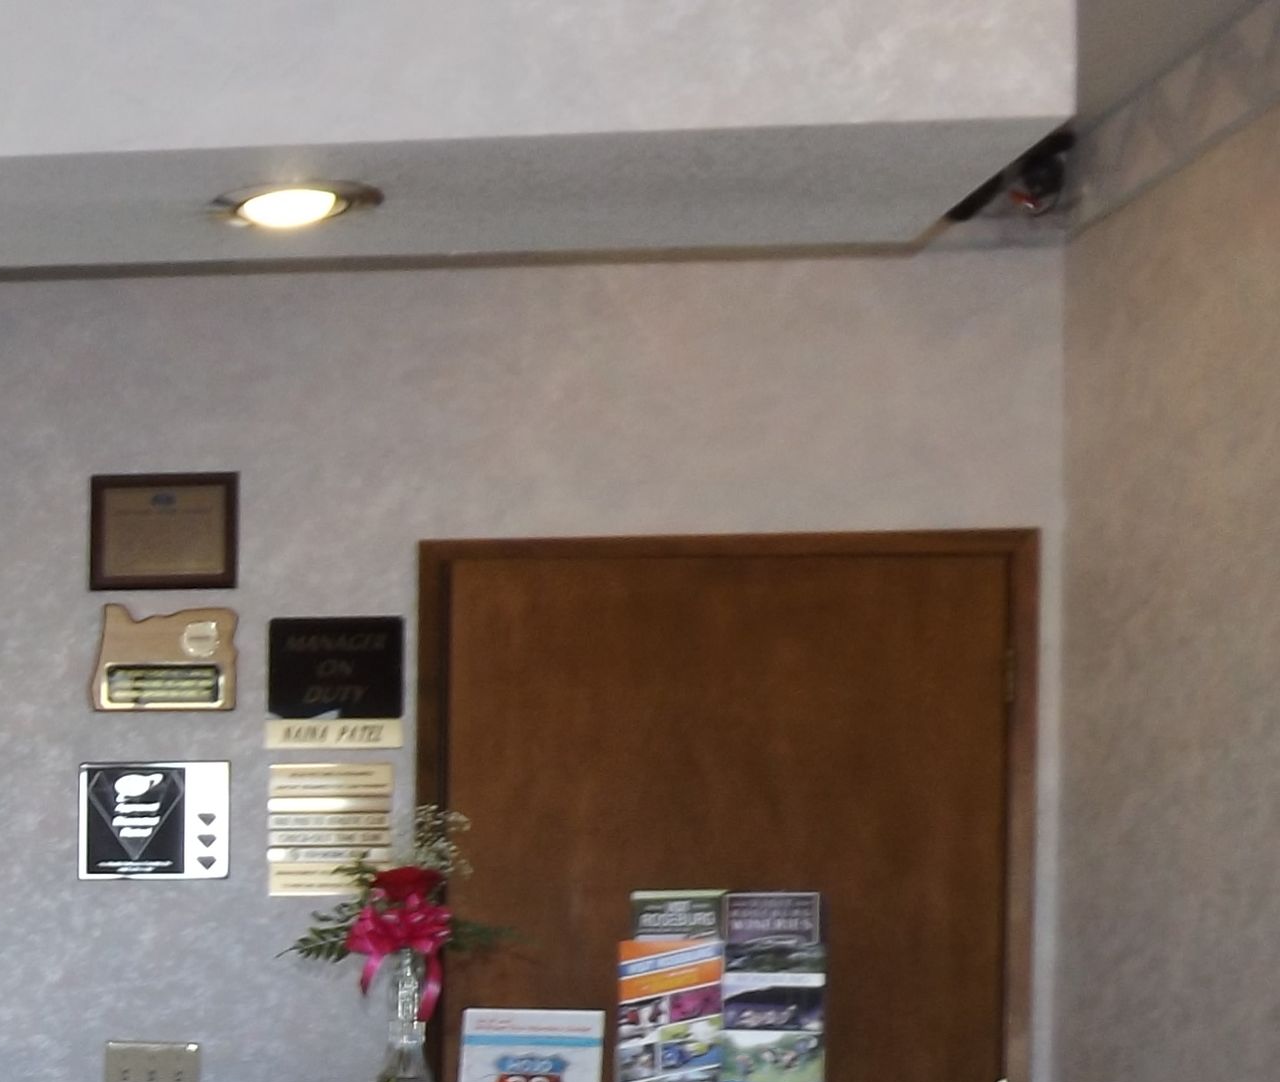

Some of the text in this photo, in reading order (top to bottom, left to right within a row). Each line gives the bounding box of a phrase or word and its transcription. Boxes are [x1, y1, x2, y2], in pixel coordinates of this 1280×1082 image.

[284, 632, 387, 652] MANAGER
[315, 658, 356, 677] ON
[302, 684, 368, 704] DUTY
